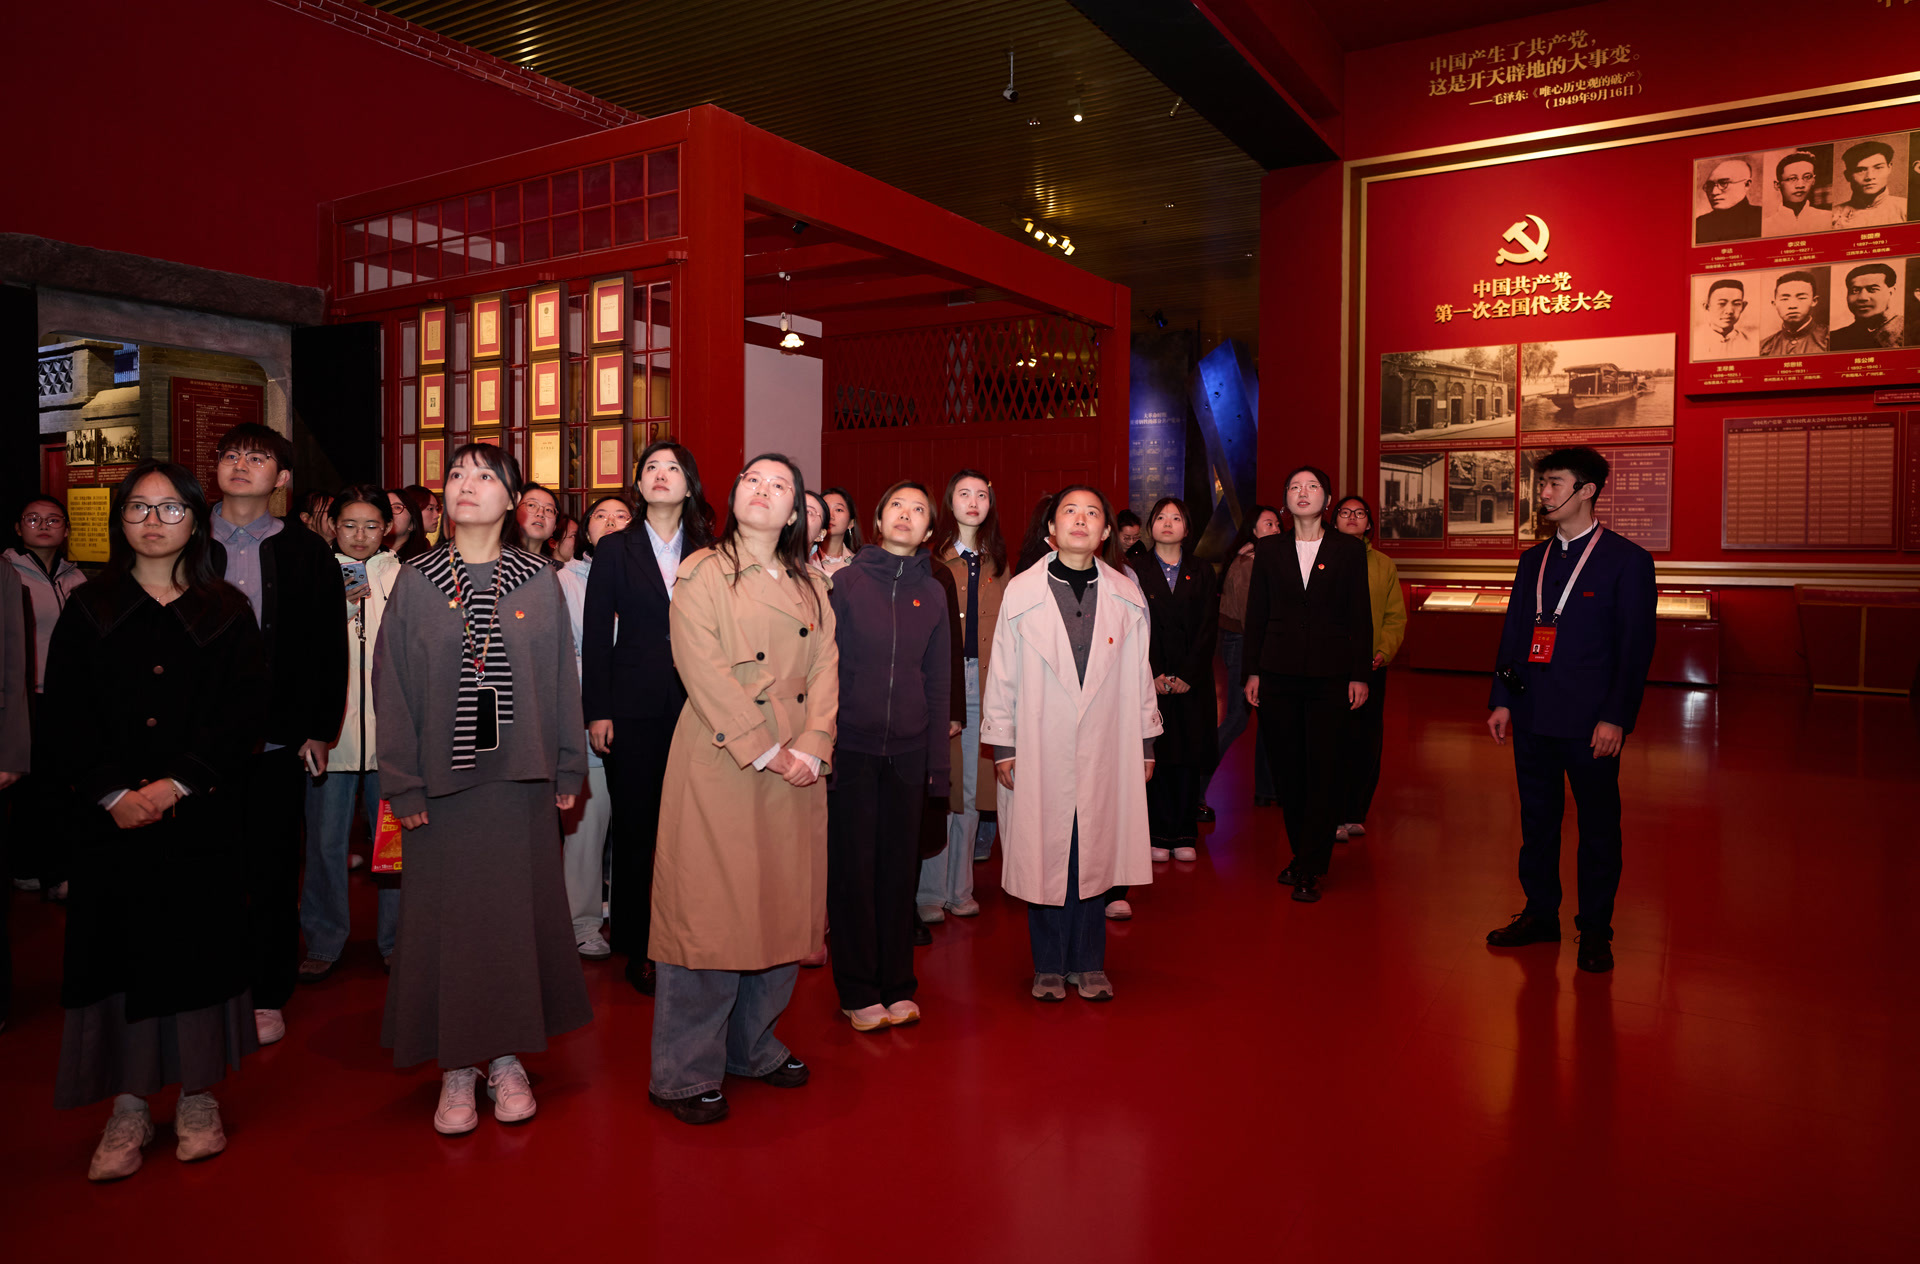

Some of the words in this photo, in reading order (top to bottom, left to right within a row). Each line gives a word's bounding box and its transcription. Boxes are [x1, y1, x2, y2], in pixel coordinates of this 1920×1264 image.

[1428, 44, 1640, 97] 这是开天辟地的大事变。
[1430, 29, 1597, 75] 中国产生了共产党，
[1473, 272, 1572, 298] 中国共产党
[1435, 290, 1613, 323] 第一次全国代表大会
